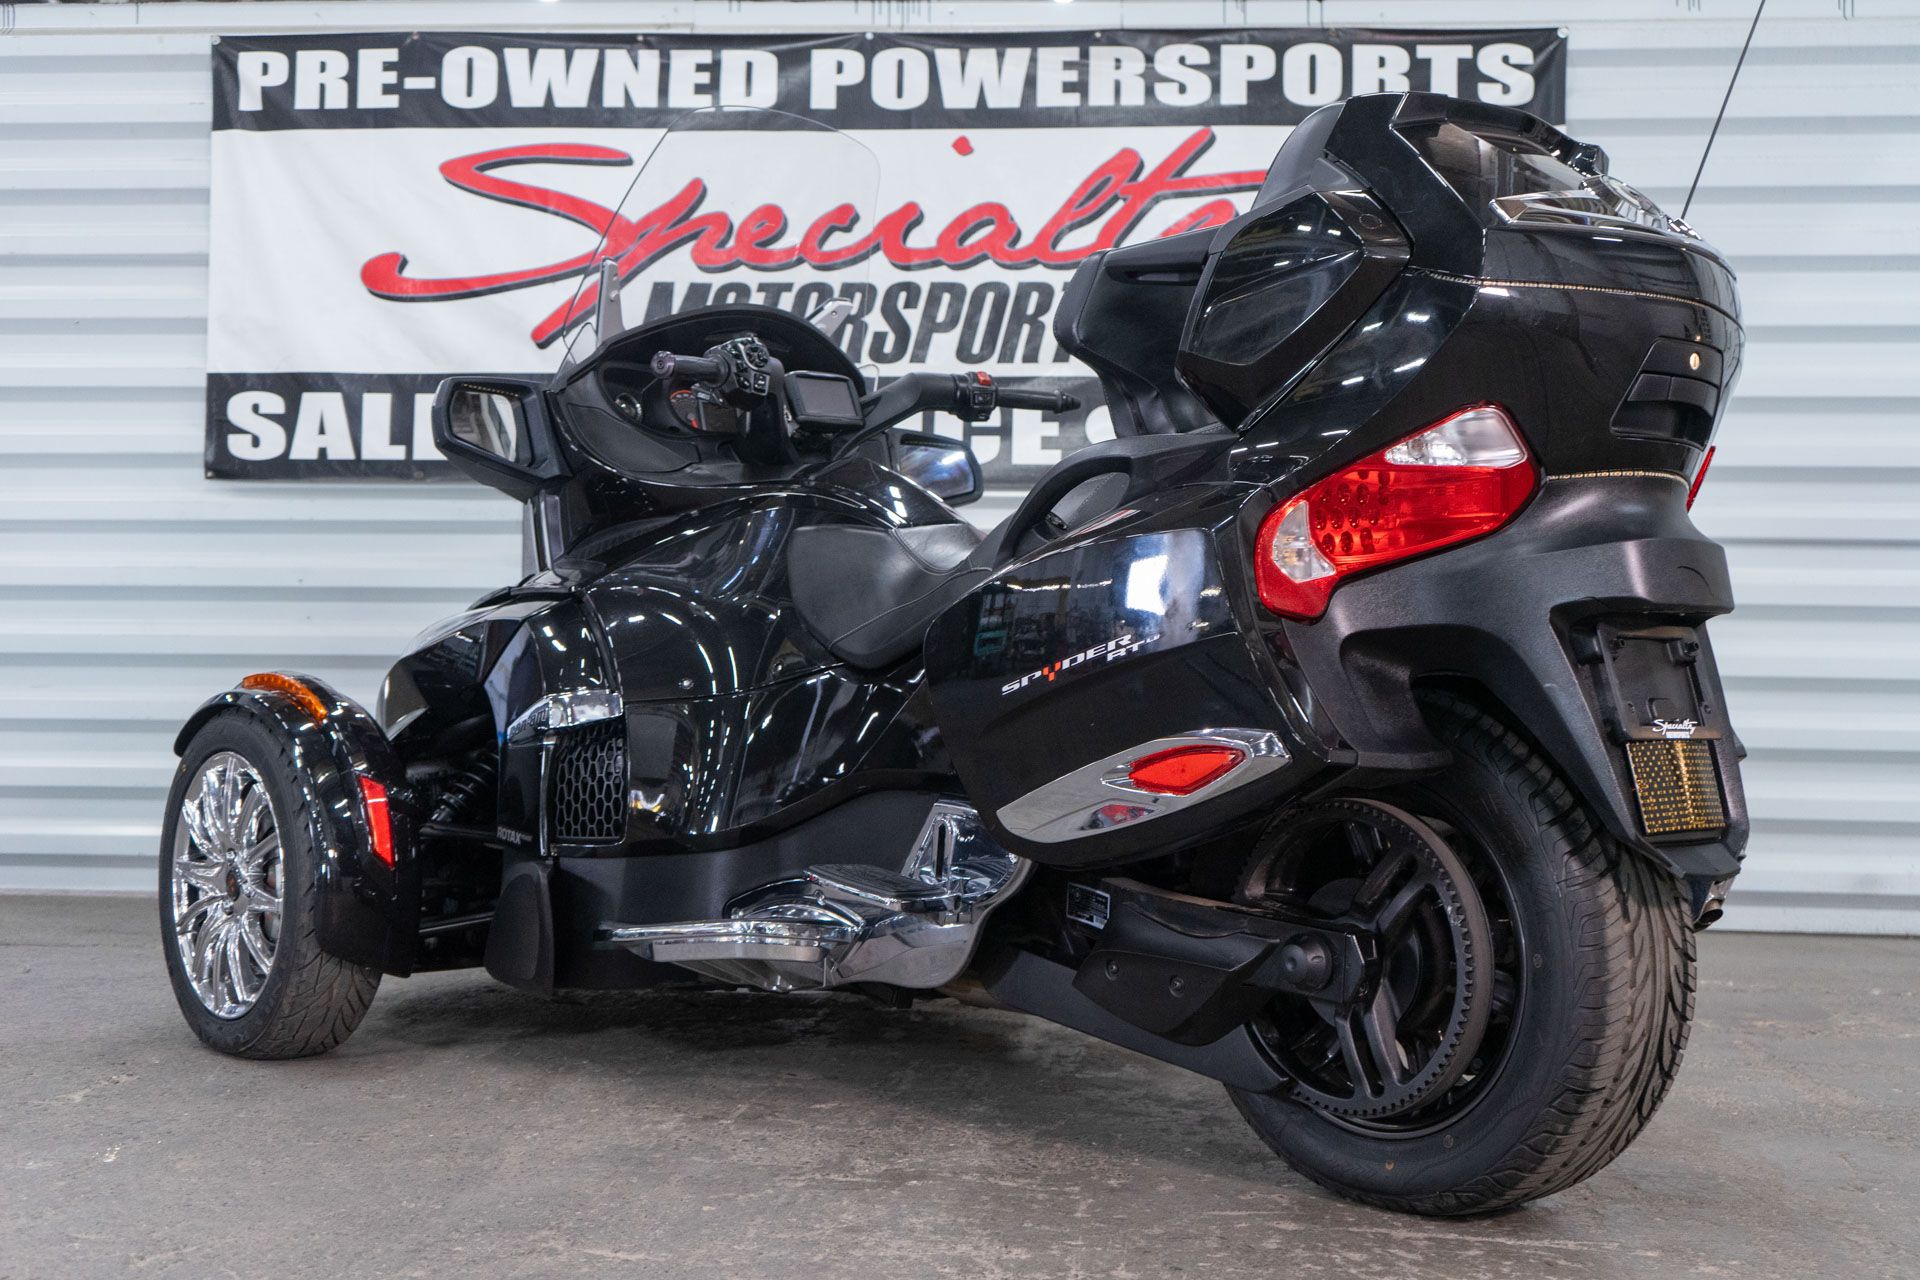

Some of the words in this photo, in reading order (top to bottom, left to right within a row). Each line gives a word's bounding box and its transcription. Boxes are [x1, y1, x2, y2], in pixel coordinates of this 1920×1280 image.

[238, 46, 778, 111] PRE-OWNED
[809, 43, 1536, 110] POWERSPORTS
[360, 126, 1268, 349] Specialt
[1002, 634, 1132, 695] SPYDER
[497, 826, 521, 845] ROTAX
